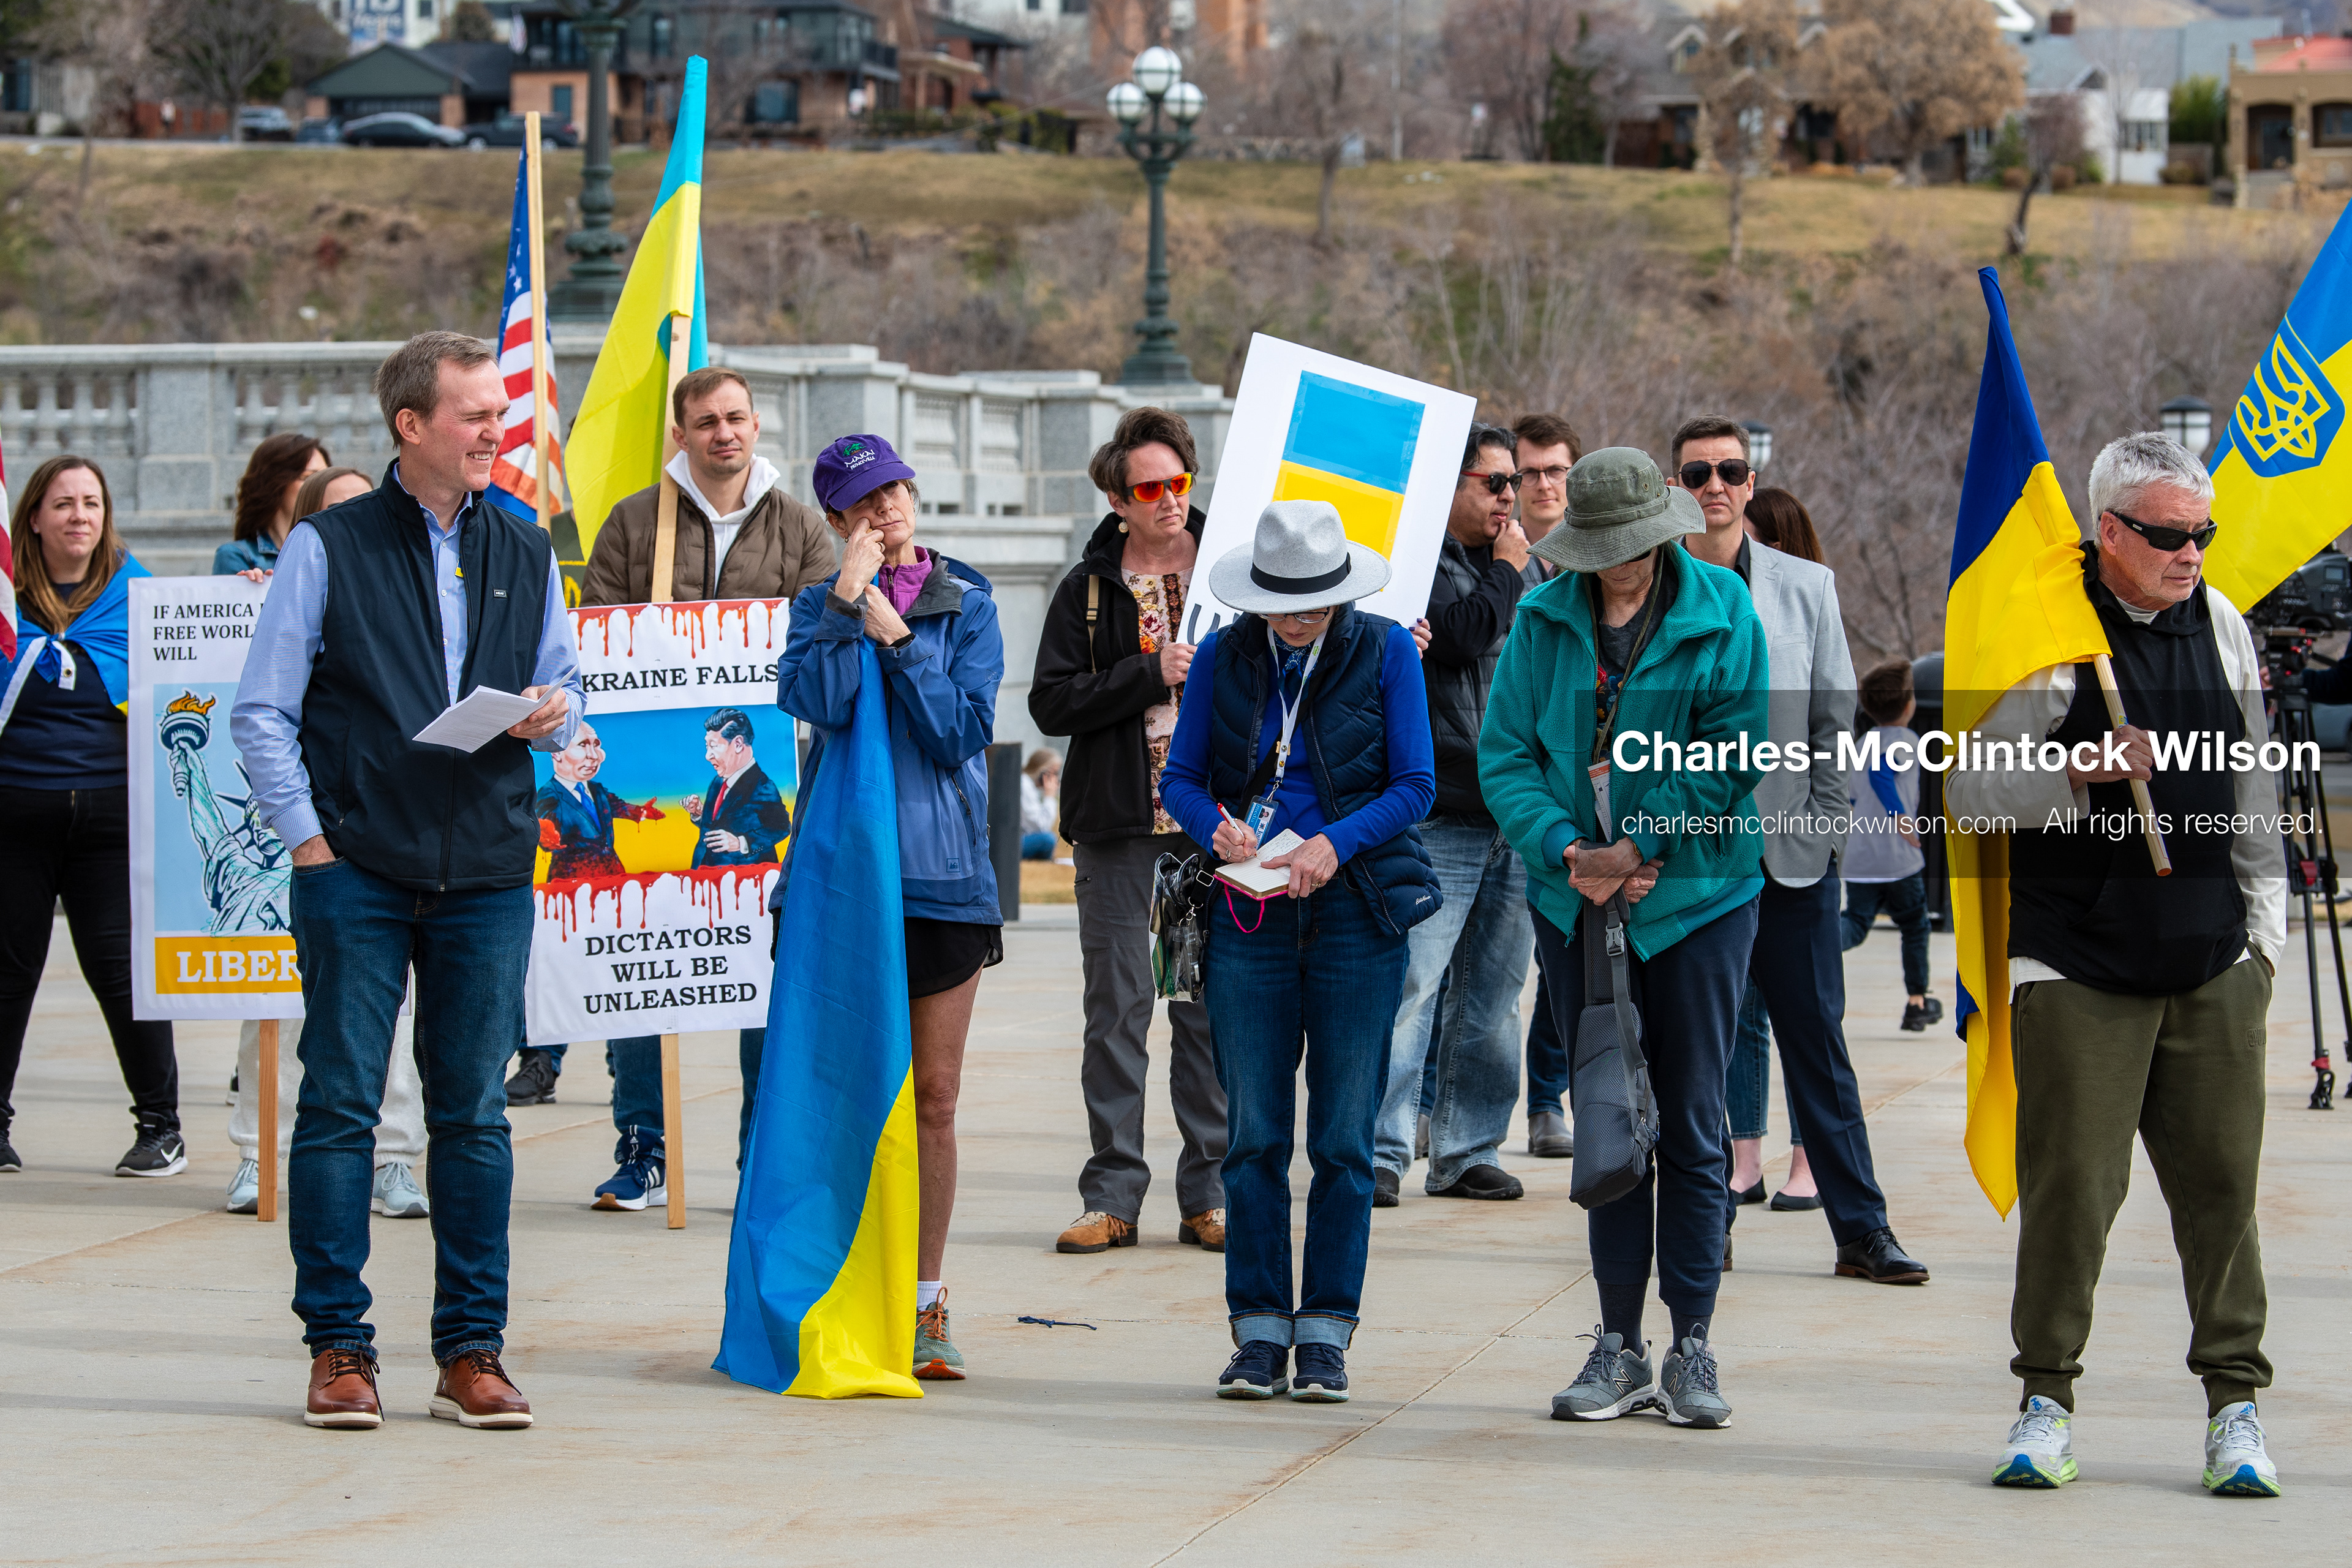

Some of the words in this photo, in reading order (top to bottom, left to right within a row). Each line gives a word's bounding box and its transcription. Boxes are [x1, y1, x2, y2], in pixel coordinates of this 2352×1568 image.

[844, 449, 875, 467] MAKAI
[153, 605, 170, 619] IF
[174, 603, 254, 619] AMERICA
[153, 626, 196, 640] FREE
[202, 625, 257, 639] WORL
[153, 647, 197, 661] WILL
[581, 668, 687, 693] KRAINE
[696, 664, 779, 685] FALLS
[585, 925, 752, 956] DICTATORS
[611, 959, 682, 982] WILL
[690, 956, 728, 977] BE
[583, 983, 757, 1014] UNLEASHED
